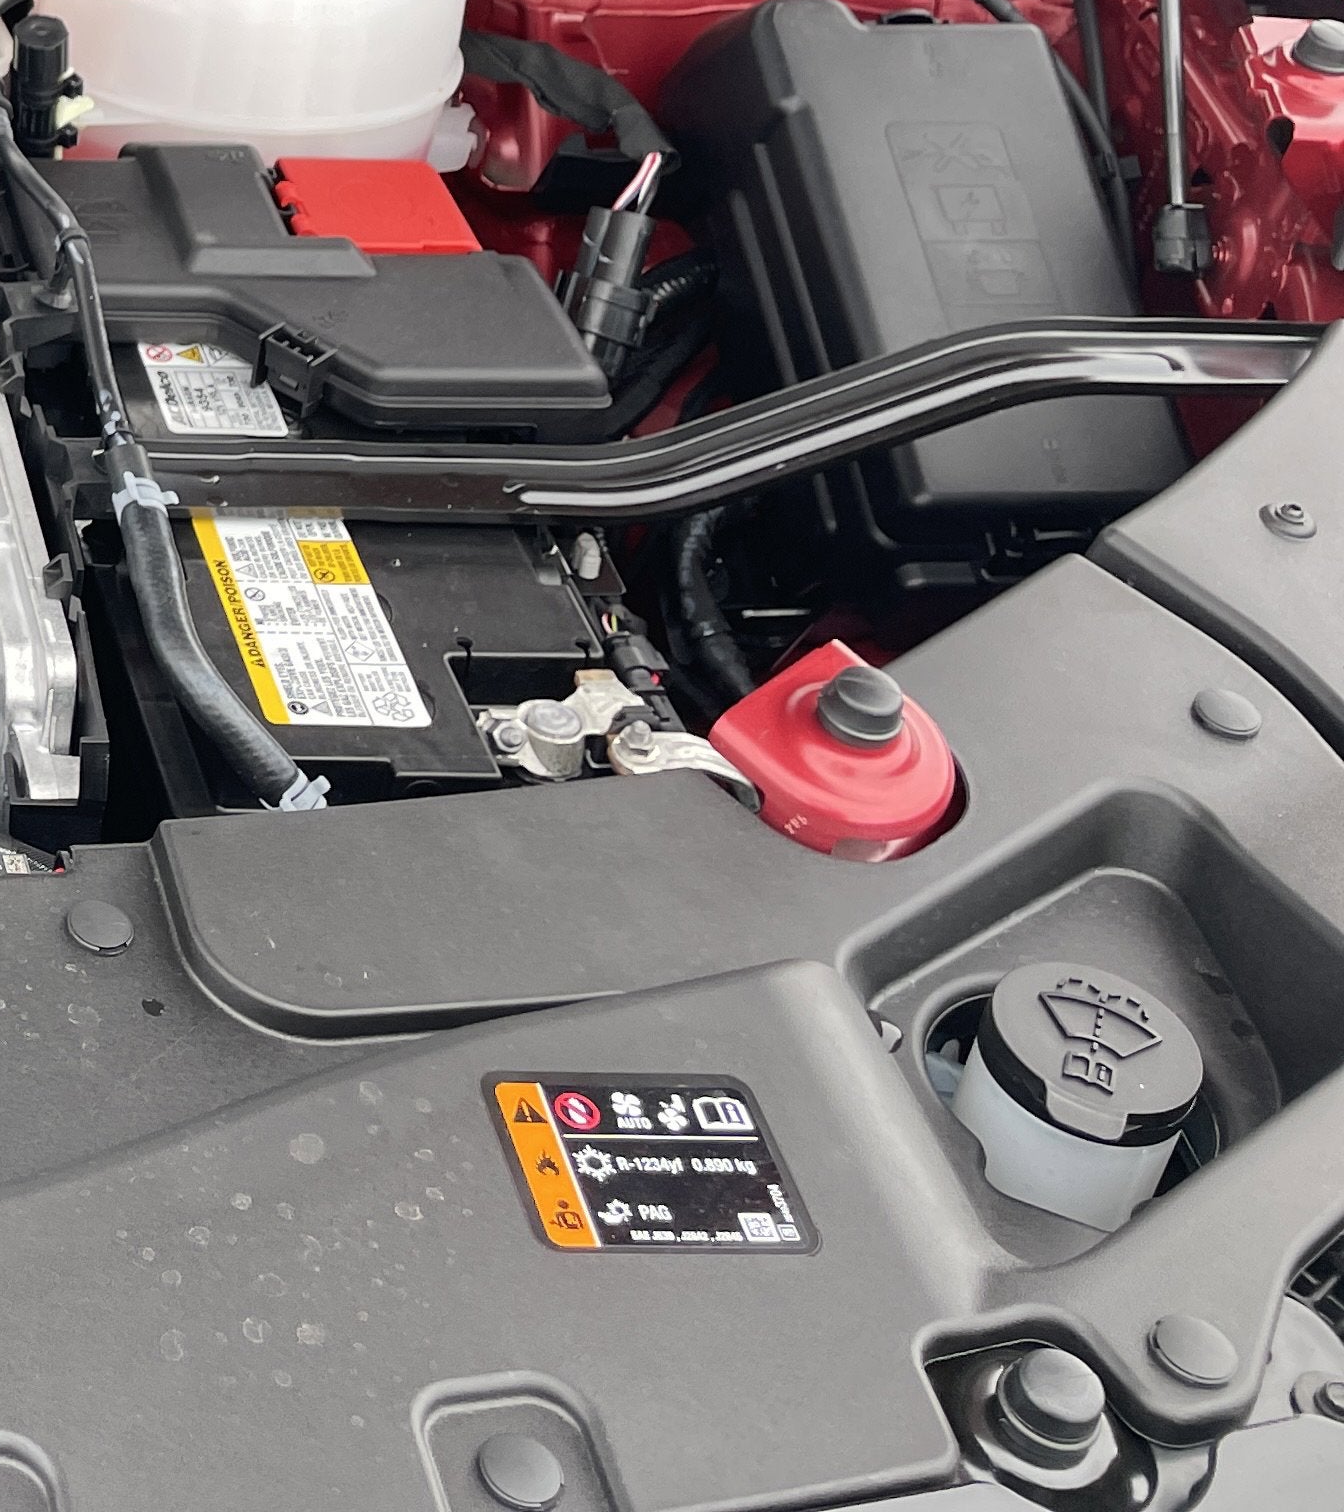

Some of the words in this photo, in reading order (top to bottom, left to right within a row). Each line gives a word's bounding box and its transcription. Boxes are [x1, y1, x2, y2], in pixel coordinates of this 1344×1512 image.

[618, 1117, 652, 1130] AUTO
[616, 1156, 684, 1174] R-1234yf
[735, 1158, 757, 1175] kg
[638, 1204, 673, 1222] PAG
